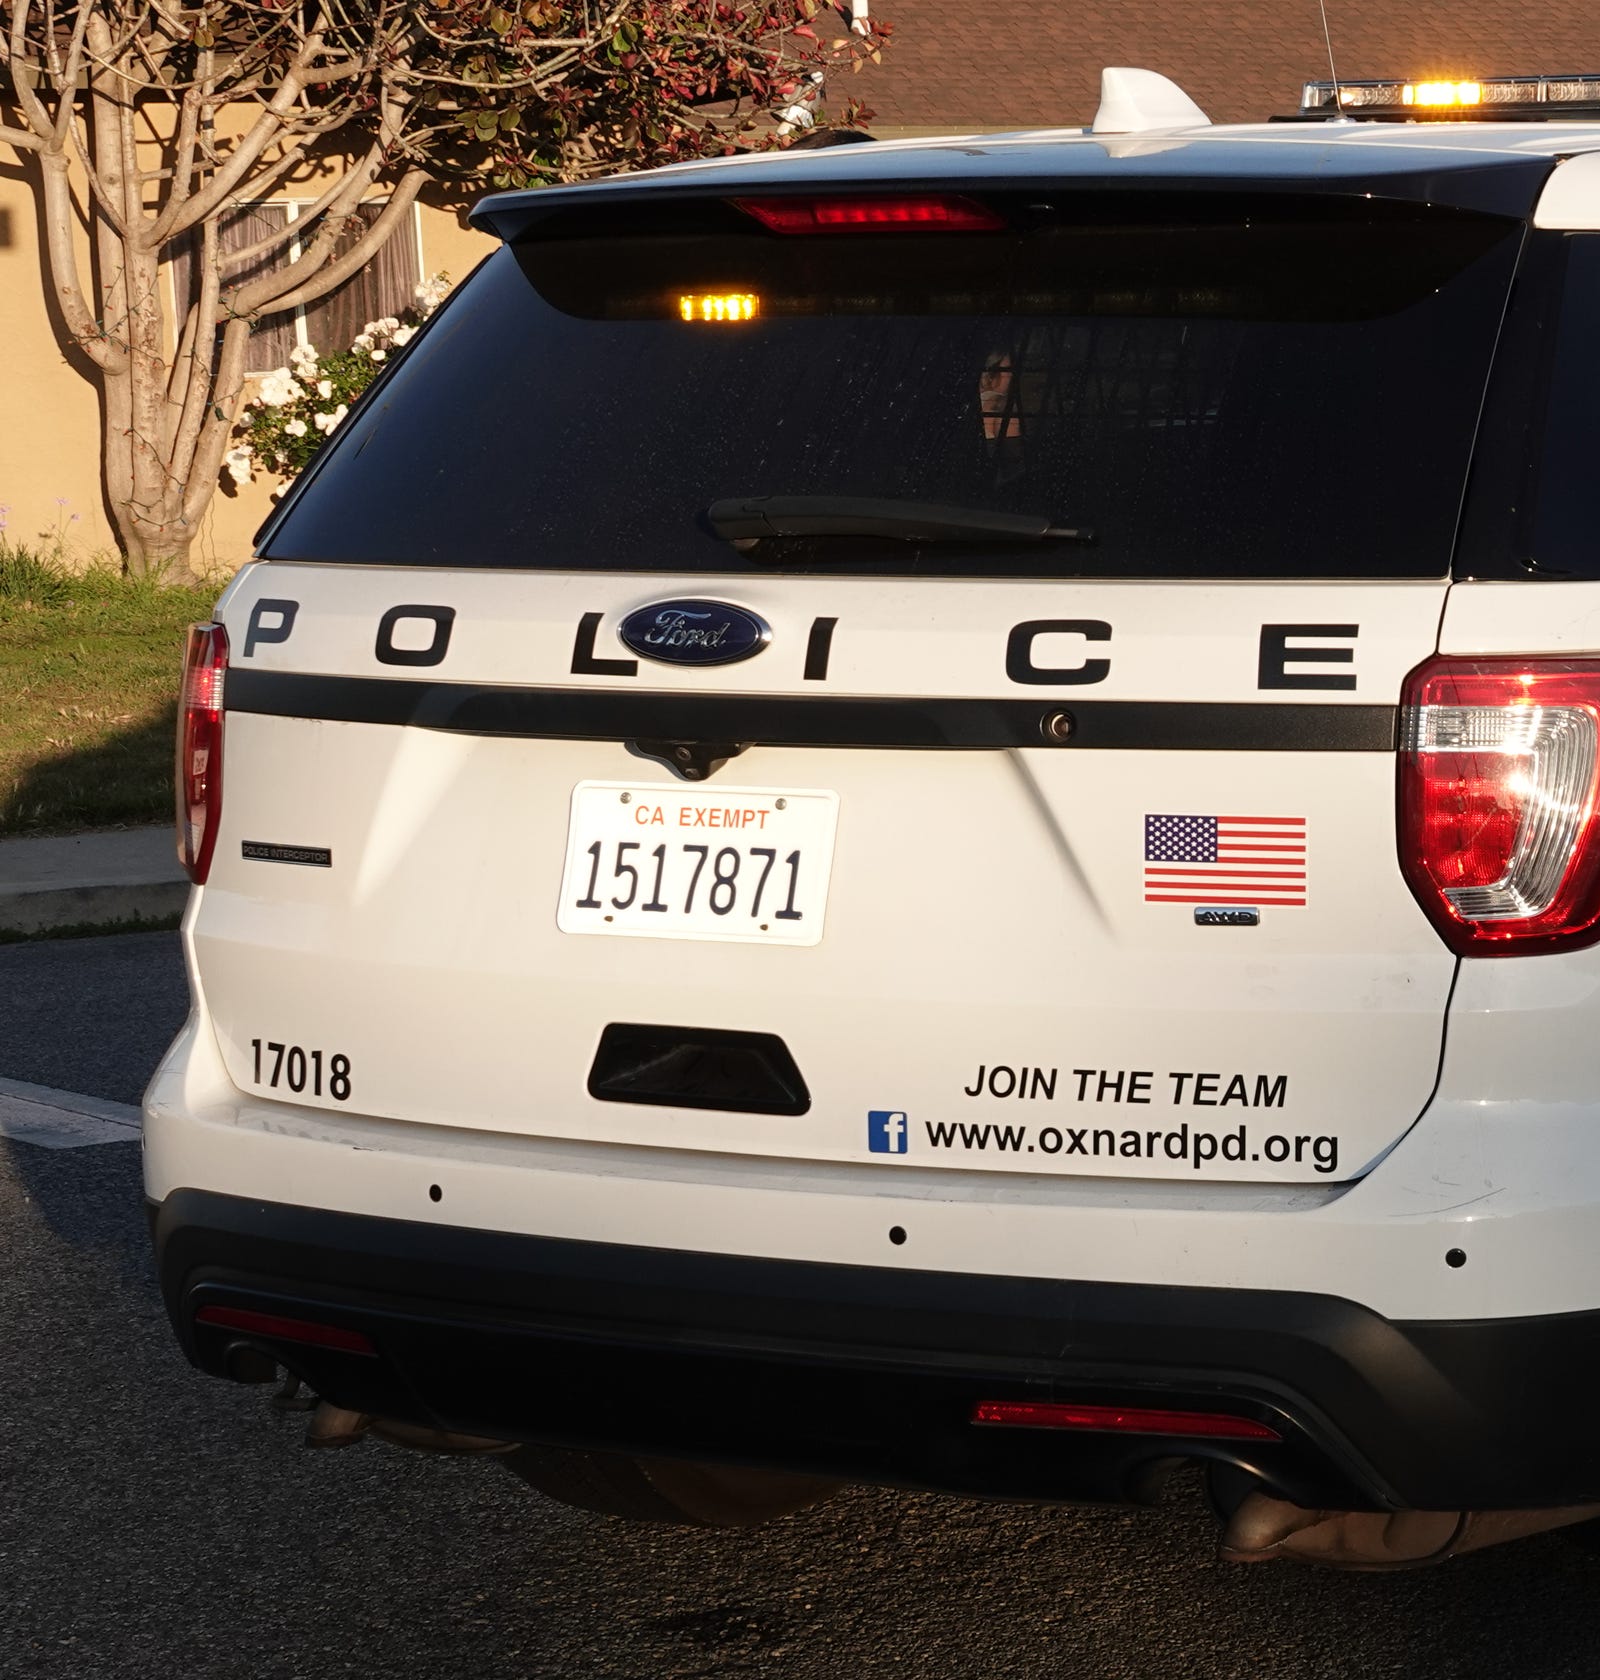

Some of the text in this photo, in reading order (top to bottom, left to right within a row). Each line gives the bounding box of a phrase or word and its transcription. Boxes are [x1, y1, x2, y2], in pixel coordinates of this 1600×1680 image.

[243, 597, 1360, 691] POLICE
[644, 609, 731, 649] Ford
[635, 805, 770, 829] CA EXEMPT
[244, 845, 328, 862] POLICE INTERCEPTOR
[576, 840, 803, 920] 1517871
[251, 1038, 351, 1101] 17018
[964, 1065, 1288, 1109] JOIN THE TEAM
[925, 1120, 1340, 1174] www.oxnardpd.org
